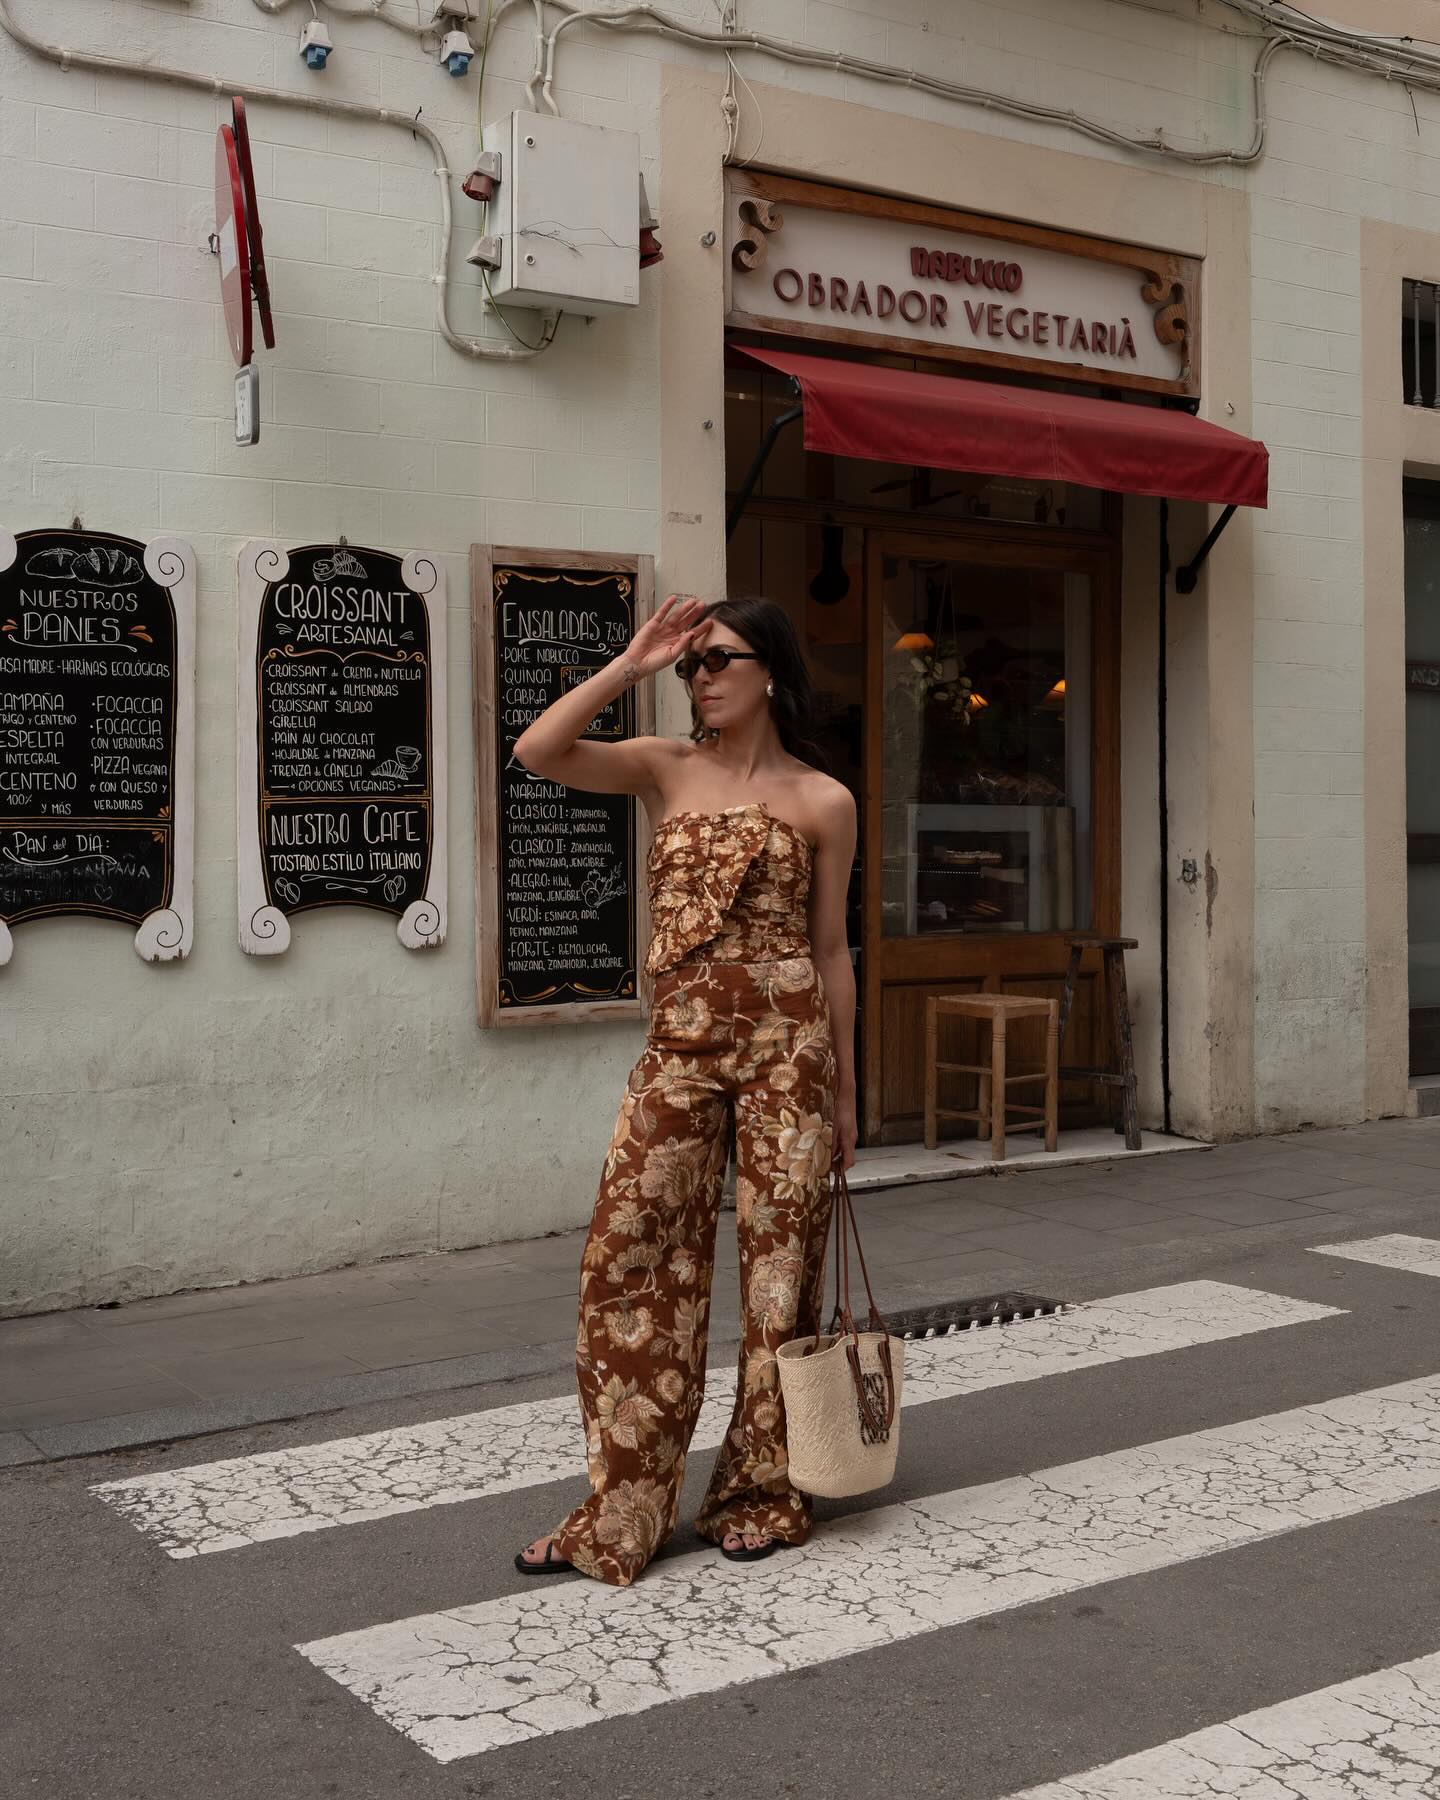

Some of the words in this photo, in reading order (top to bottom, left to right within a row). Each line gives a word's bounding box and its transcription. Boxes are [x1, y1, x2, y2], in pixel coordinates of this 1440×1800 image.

[911, 247, 1023, 292] NABUCCO
[773, 268, 948, 328] OBRADOR
[963, 299, 1138, 359] VEGETARIÀ
[19, 588, 139, 613] NUESTROS
[275, 583, 410, 624] CROISSANT
[23, 611, 121, 643] PANES
[502, 602, 601, 641] ENSALADAS
[296, 623, 398, 647] ARTESANAL
[504, 646, 531, 664] POKE
[536, 647, 580, 665] NABUCCO
[0, 657, 21, 674] ASA
[111, 659, 171, 678] ECOLÓGICAS
[268, 662, 328, 678] CROISSANT
[343, 664, 372, 679] CREMA
[381, 667, 422, 681] NUTELLA
[504, 666, 552, 685] QUINOA
[270, 681, 327, 696] CROISSANT
[343, 683, 399, 698] ALMENDRAS
[506, 688, 547, 704] CABRA
[96, 695, 164, 715] FOCACCIA
[271, 697, 329, 713] CROISSANT
[335, 700, 373, 714] SALADO
[34, 713, 78, 727] CENTENO
[95, 717, 162, 736] FOCACCIA
[272, 714, 316, 729] GIRELLA
[91, 737, 109, 750] CON
[112, 737, 165, 751] VERDURAS
[274, 730, 298, 746] PAIN
[302, 732, 315, 745] AU
[319, 732, 375, 746] CHOCOLAT
[5, 752, 61, 766] INTEGRAL
[274, 748, 320, 760] HOJALDRE
[332, 748, 376, 760] MANZANA
[93, 753, 131, 776] PIZZA
[132, 764, 168, 777] VEGANA
[271, 764, 312, 777] TRENZA
[323, 763, 363, 778] CANELA
[0, 771, 78, 791] CENTENO
[100, 781, 118, 794] CON
[121, 779, 158, 795] QUESO
[298, 779, 344, 793] OPCIONES
[350, 779, 396, 793] VEGANAS
[6, 793, 33, 806] 100%
[510, 783, 567, 799] NARANJA
[51, 802, 72, 815] MÁS
[93, 799, 144, 812] VERDURAS
[510, 802, 557, 819] CLASICO
[271, 812, 350, 847] NUESTRO
[52, 837, 67, 851] del
[511, 838, 554, 855] CLASICO
[270, 853, 320, 872] TOSTADO
[322, 851, 364, 871] ESTILO
[369, 850, 422, 871] ITALIANO
[539, 925, 578, 936] MANZANA
